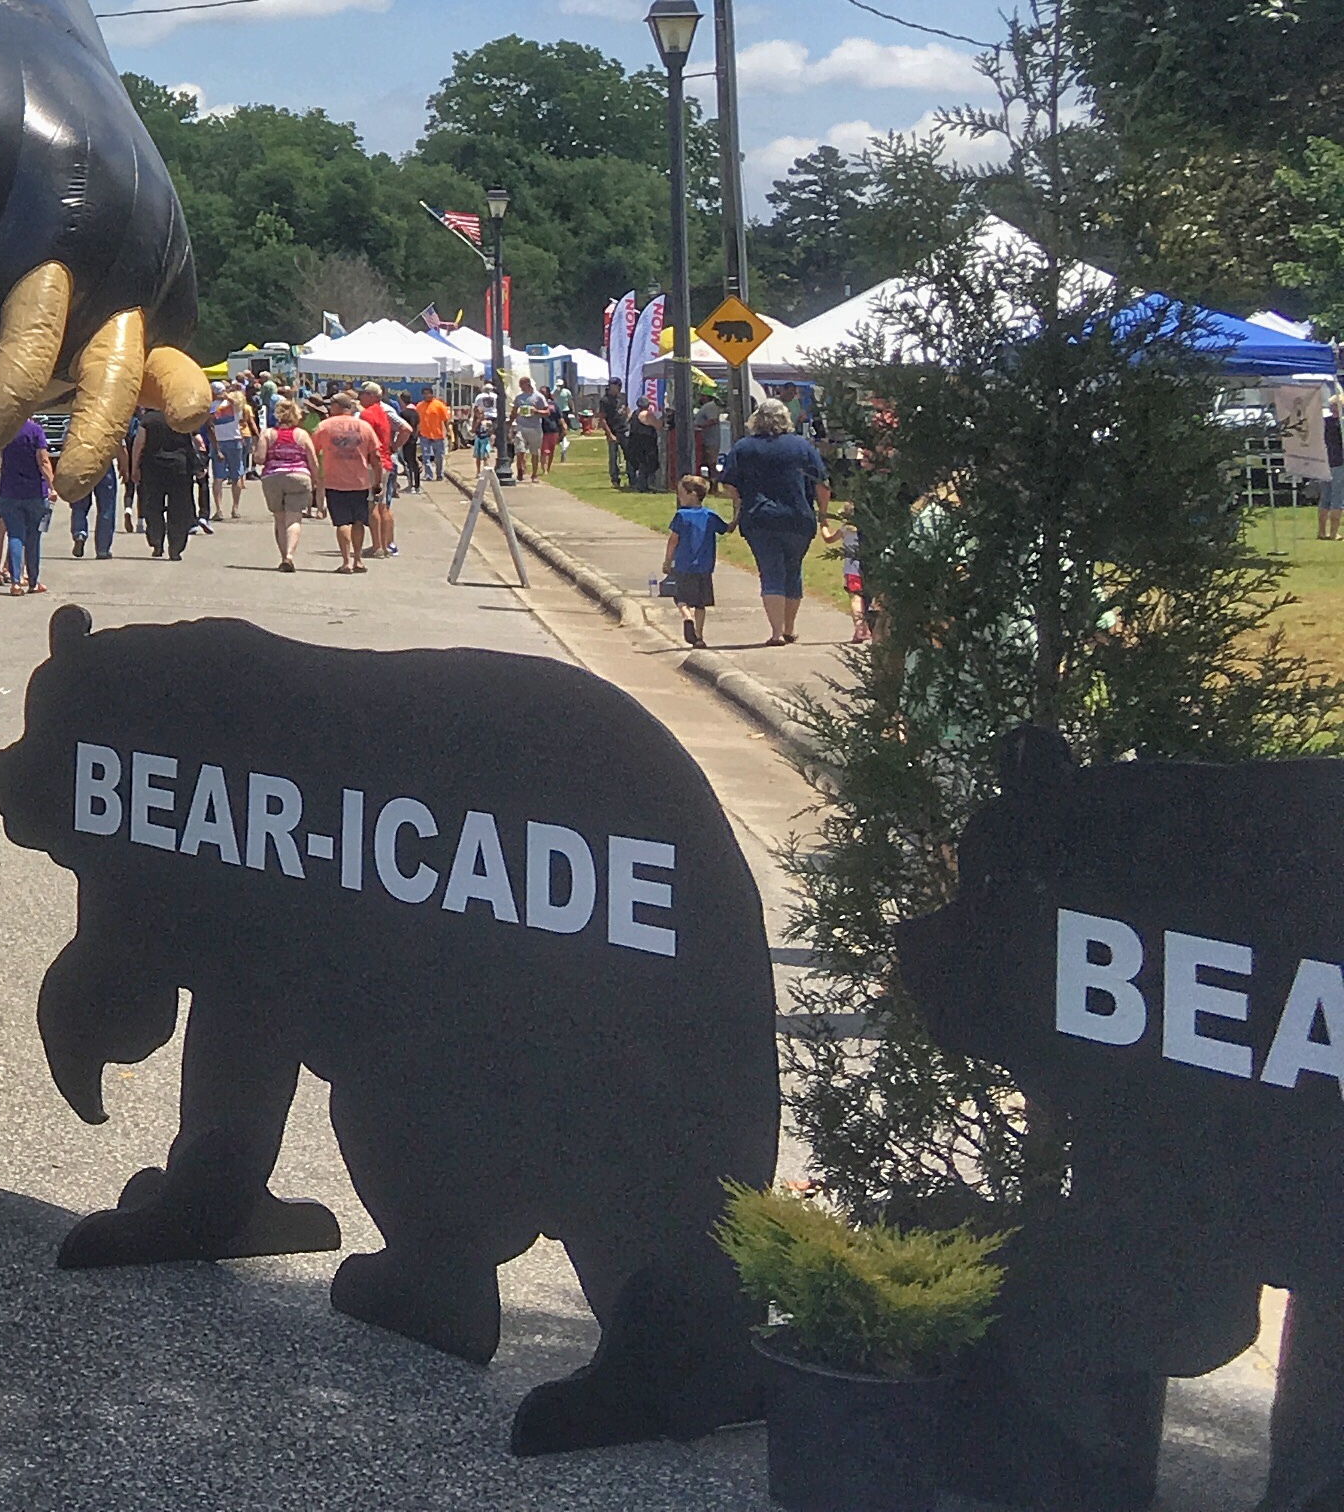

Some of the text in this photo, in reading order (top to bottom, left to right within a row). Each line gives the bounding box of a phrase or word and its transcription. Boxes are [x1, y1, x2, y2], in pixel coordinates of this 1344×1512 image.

[624, 298, 636, 338] NOW
[650, 302, 665, 347] NOW
[73, 741, 677, 958] BEAR-ICADE
